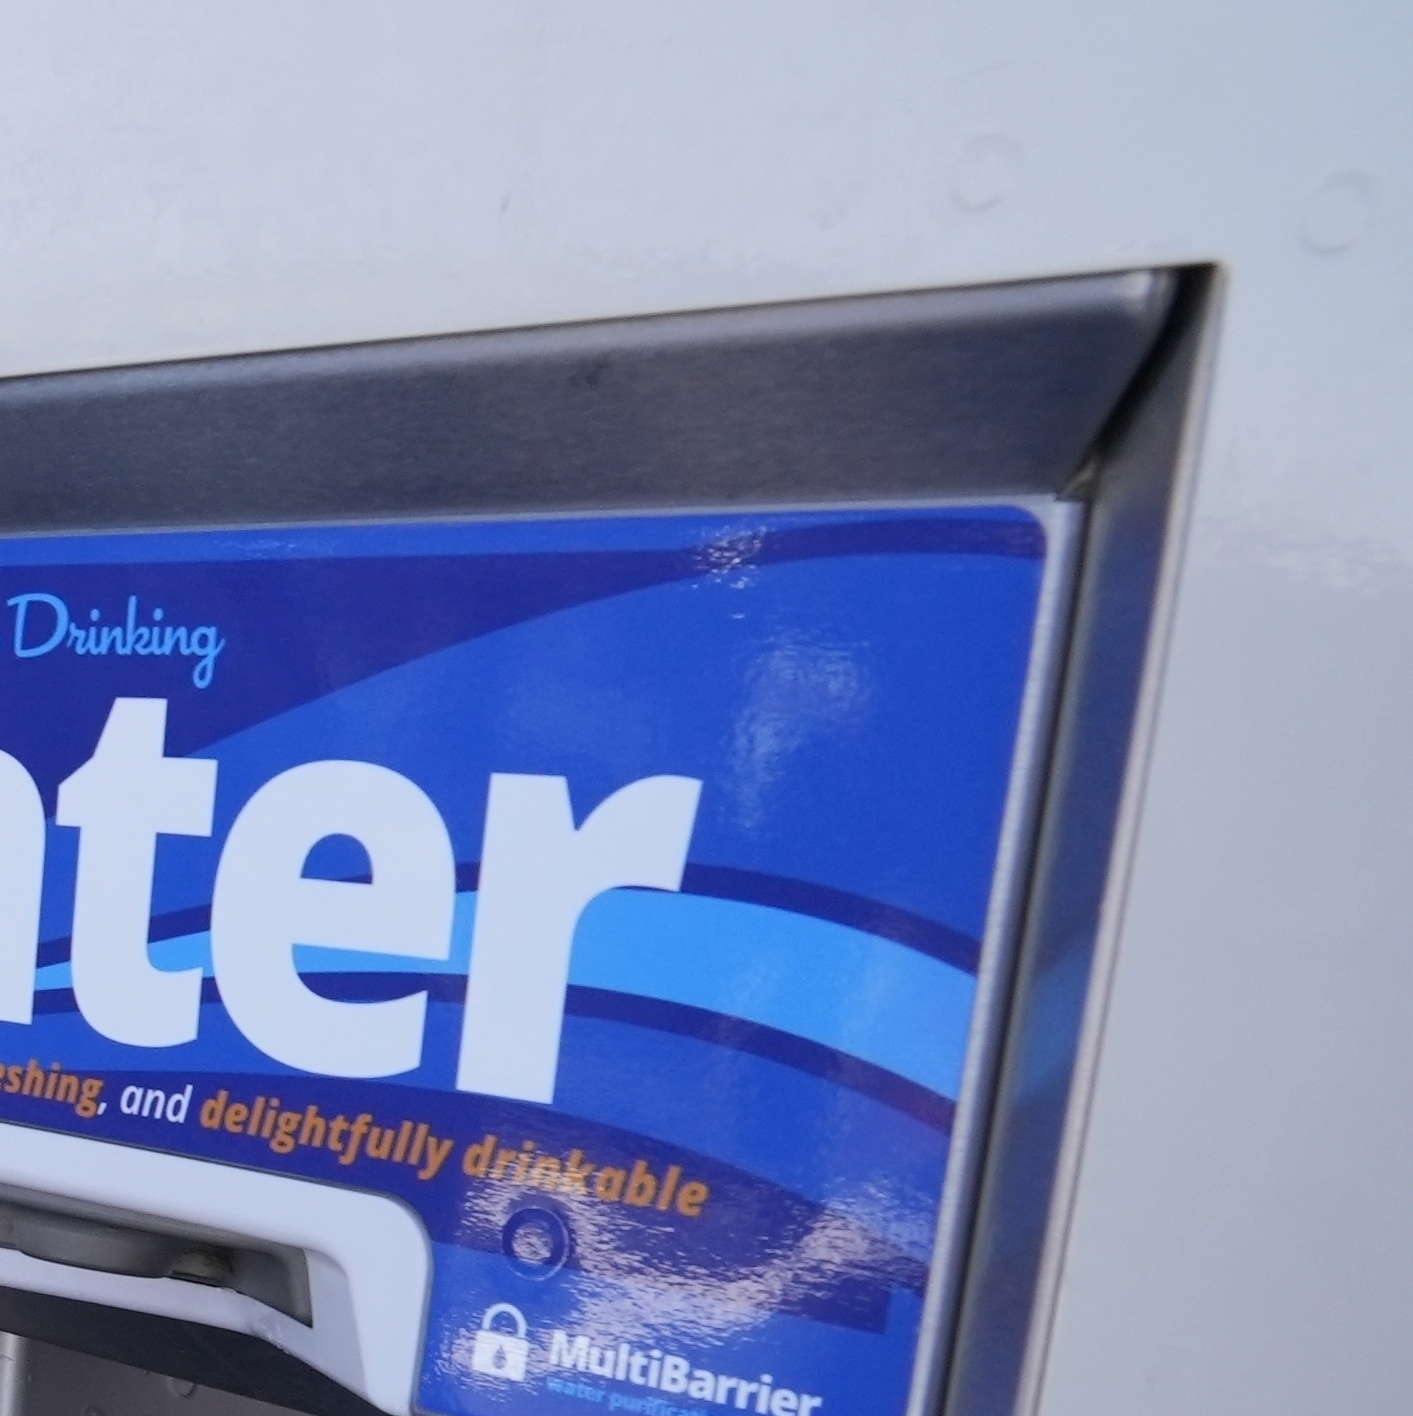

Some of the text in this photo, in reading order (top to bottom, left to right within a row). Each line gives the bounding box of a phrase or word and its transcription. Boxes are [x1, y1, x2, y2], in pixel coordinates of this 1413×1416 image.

[7, 592, 226, 689] Drinking
[119, 1081, 193, 1124] and
[200, 1089, 453, 1180] delightfully
[464, 1133, 711, 1218] drinkable
[546, 1377, 605, 1402] water
